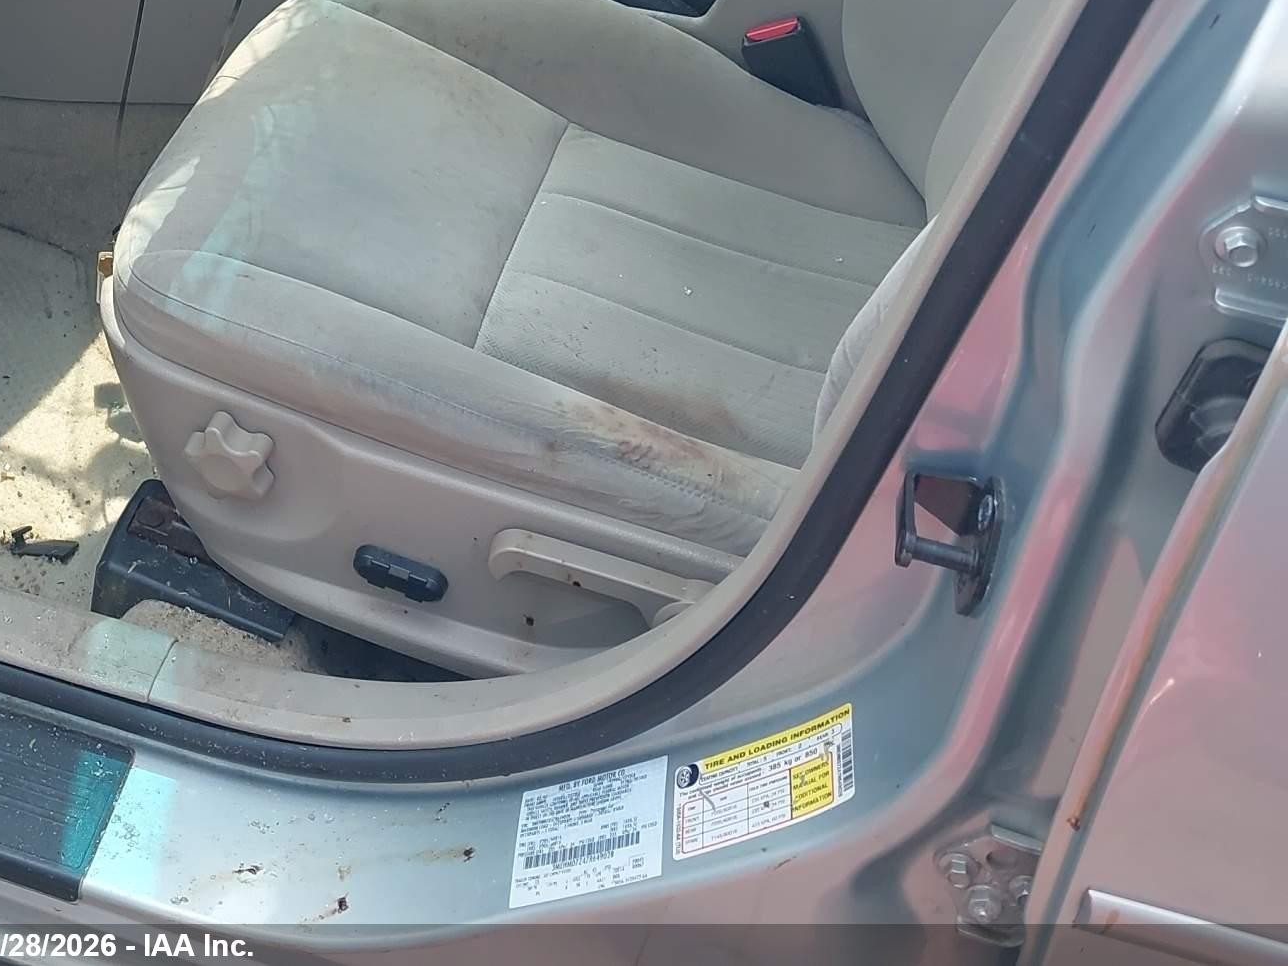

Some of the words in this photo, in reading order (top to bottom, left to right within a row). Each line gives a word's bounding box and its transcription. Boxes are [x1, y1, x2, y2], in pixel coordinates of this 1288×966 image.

[705, 758, 725, 770] TIRE
[728, 752, 746, 762] AND
[749, 736, 788, 754] LOADING
[791, 708, 850, 740] INFORMATION
[769, 762, 781, 771] 385
[805, 748, 818, 758] 850
[582, 776, 596, 786] FORD
[597, 772, 616, 782] MOTOR
[819, 771, 829, 779] FOR
